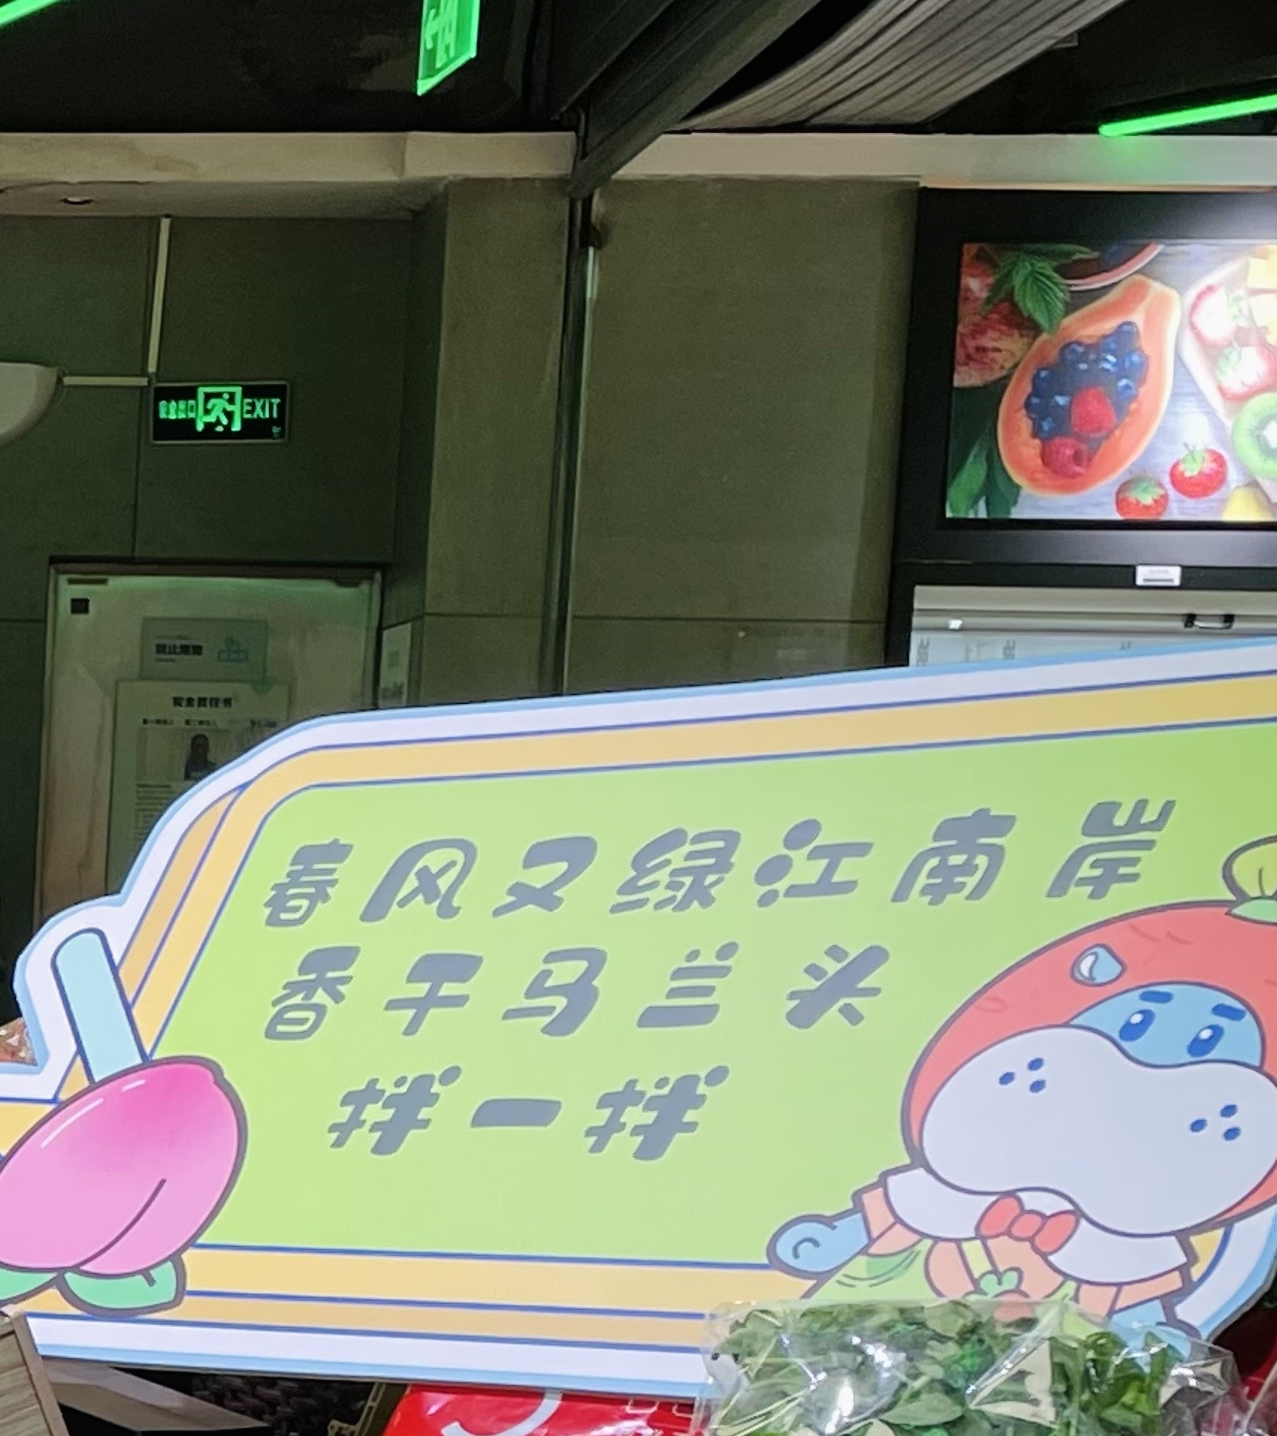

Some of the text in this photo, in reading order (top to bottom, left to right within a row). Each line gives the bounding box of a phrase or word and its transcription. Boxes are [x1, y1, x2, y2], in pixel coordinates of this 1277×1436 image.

[242, 398, 281, 419] EXIT
[262, 798, 1177, 930] 春风又绿江南岸
[262, 940, 893, 1042] 香干马兰头
[327, 1064, 731, 1161] 拌一拌
